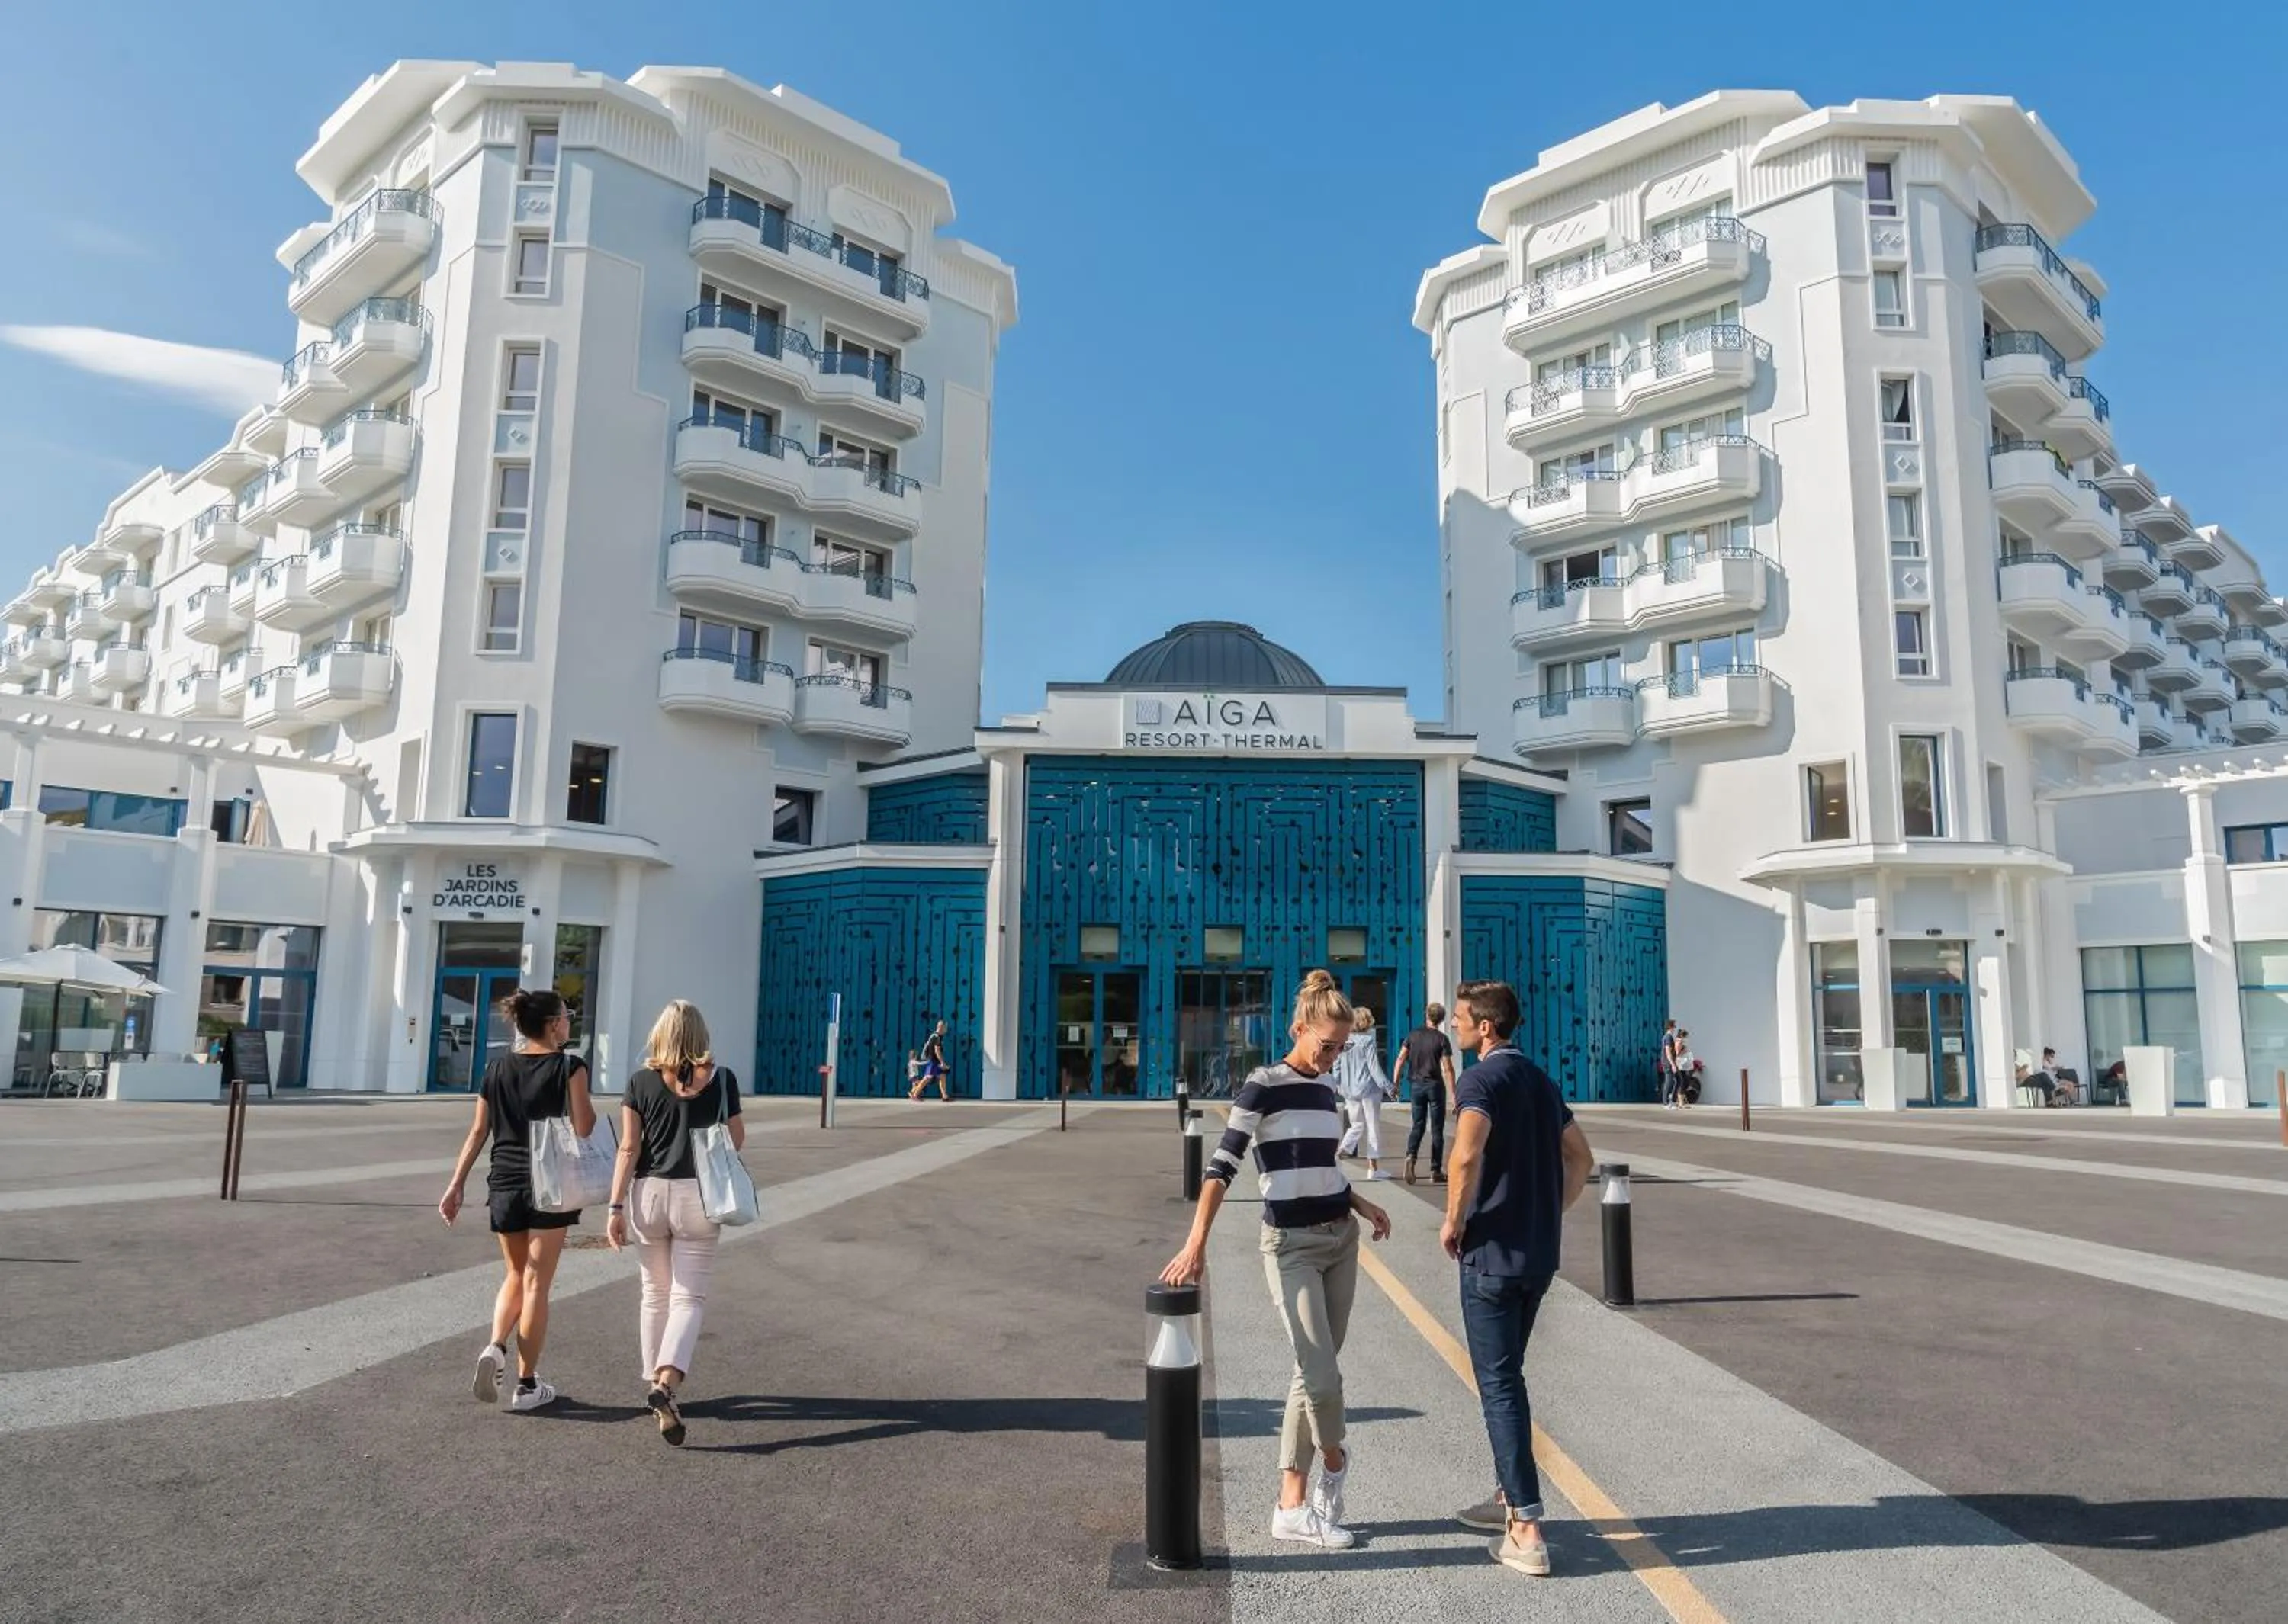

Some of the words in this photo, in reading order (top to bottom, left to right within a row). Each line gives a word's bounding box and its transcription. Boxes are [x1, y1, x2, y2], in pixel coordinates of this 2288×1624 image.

[1173, 695, 1277, 726] AÏGA
[467, 864, 496, 878] LES
[445, 879, 518, 893] JARDINS
[432, 894, 525, 908] D'ARCADIE
